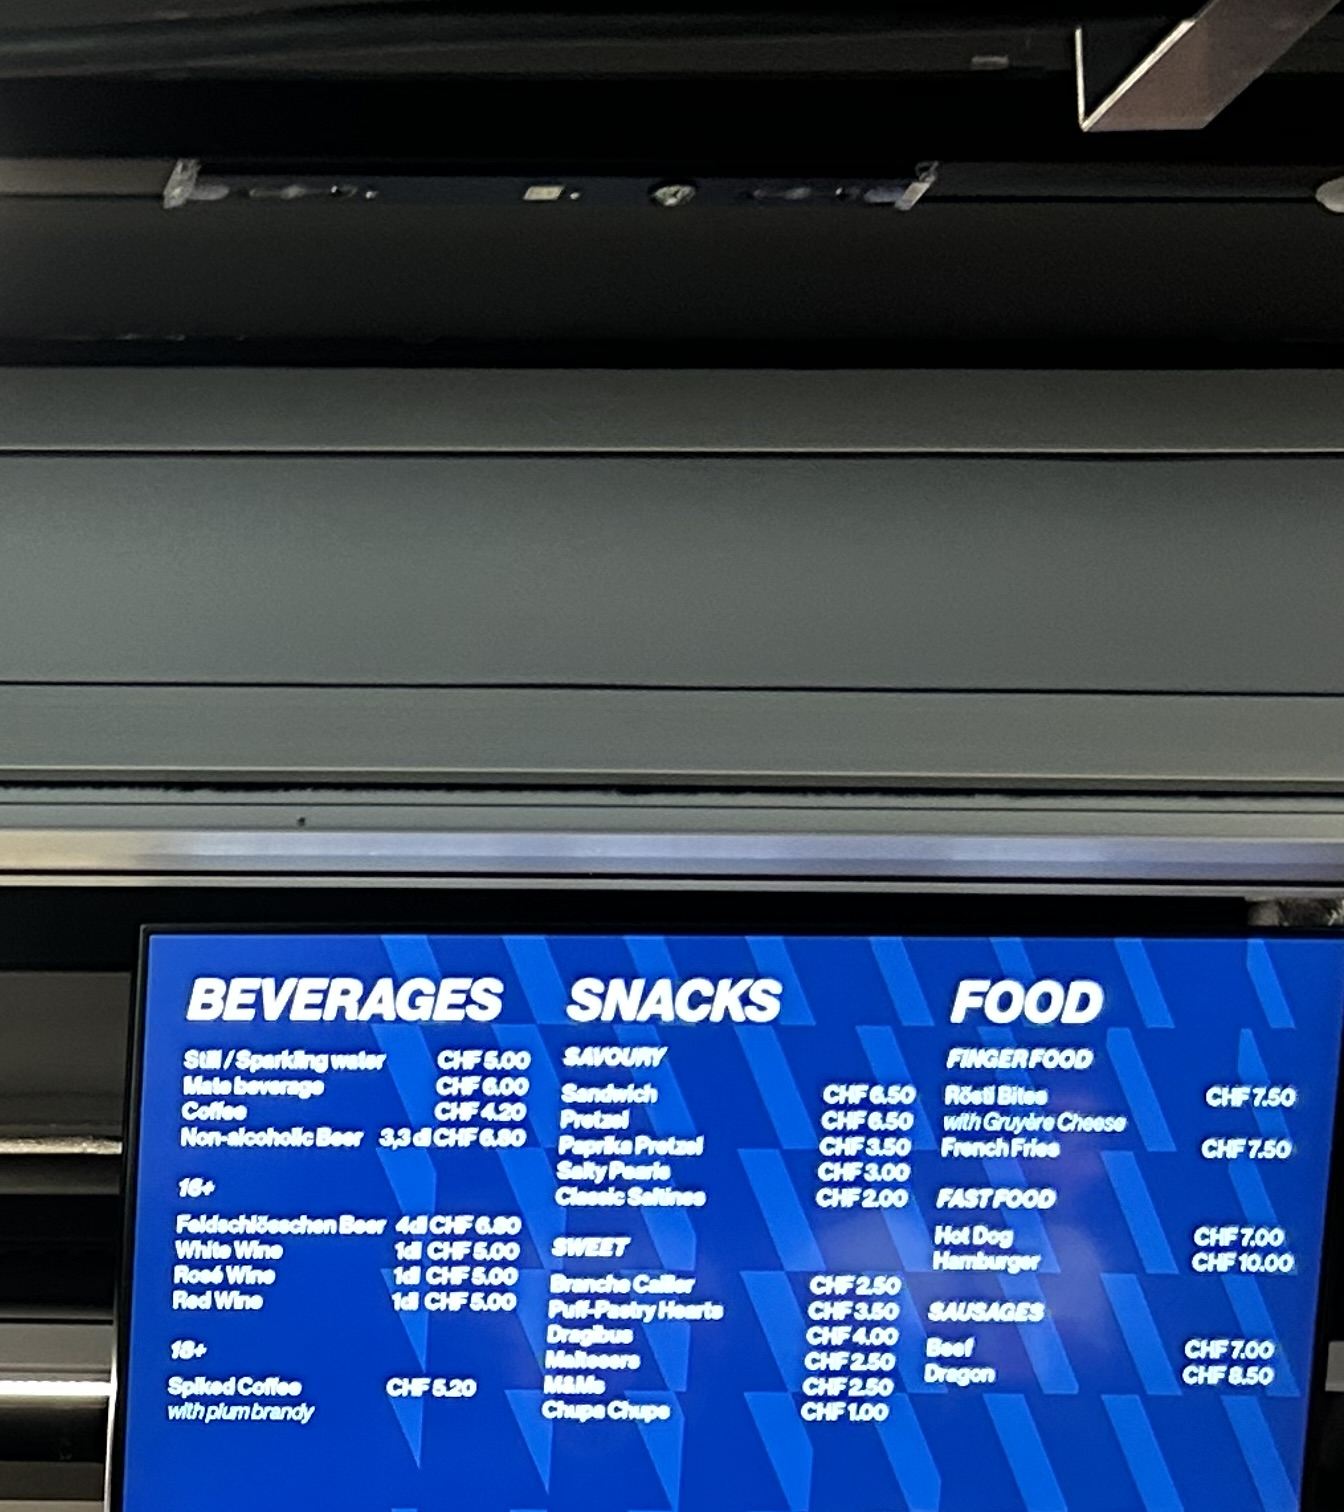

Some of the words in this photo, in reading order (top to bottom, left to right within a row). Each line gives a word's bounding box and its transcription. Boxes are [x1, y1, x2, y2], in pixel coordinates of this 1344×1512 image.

[186, 977, 504, 1022] BEVERAGES
[566, 977, 783, 1023] SNACKS
[950, 979, 1104, 1024] FOOD
[563, 1046, 668, 1067] SAVOURY
[946, 1047, 1029, 1069] FINGER
[1028, 1048, 1094, 1069] FOOD
[561, 1083, 658, 1103] Sandwich
[944, 1084, 995, 1105] Rösti
[997, 1085, 1048, 1106] Bites
[1205, 1086, 1251, 1107] CHF
[1252, 1087, 1296, 1107] 7.50
[181, 1100, 248, 1121] Coffee
[943, 1112, 982, 1131] with
[983, 1111, 1055, 1135] Gruyère
[1057, 1111, 1127, 1132] Cheese
[940, 1136, 1010, 1158] French
[1010, 1138, 1061, 1158] Fries
[1201, 1138, 1247, 1159] CHF
[1248, 1139, 1292, 1159] 7.50
[936, 1188, 994, 1209] FAST
[992, 1188, 1057, 1209] FOOD
[551, 1237, 632, 1257] SWEET
[934, 1225, 970, 1245] Hot
[972, 1225, 1014, 1249] Dog
[1194, 1226, 1239, 1247] CHF
[1240, 1228, 1285, 1247] 7.00
[932, 1250, 1041, 1274] Hamburger
[1192, 1252, 1237, 1272] CHF
[1238, 1253, 1295, 1273] 10.00
[927, 1301, 1046, 1322] SAUSAGES
[926, 1337, 975, 1358] Beef
[1184, 1339, 1230, 1359] CHF
[1230, 1340, 1275, 1359] 7.00
[923, 1363, 996, 1387] Dragon
[1182, 1365, 1227, 1385] CHF
[1228, 1366, 1274, 1385] 8.50
[167, 1376, 236, 1399] Spiked
[237, 1377, 302, 1396] Coffee
